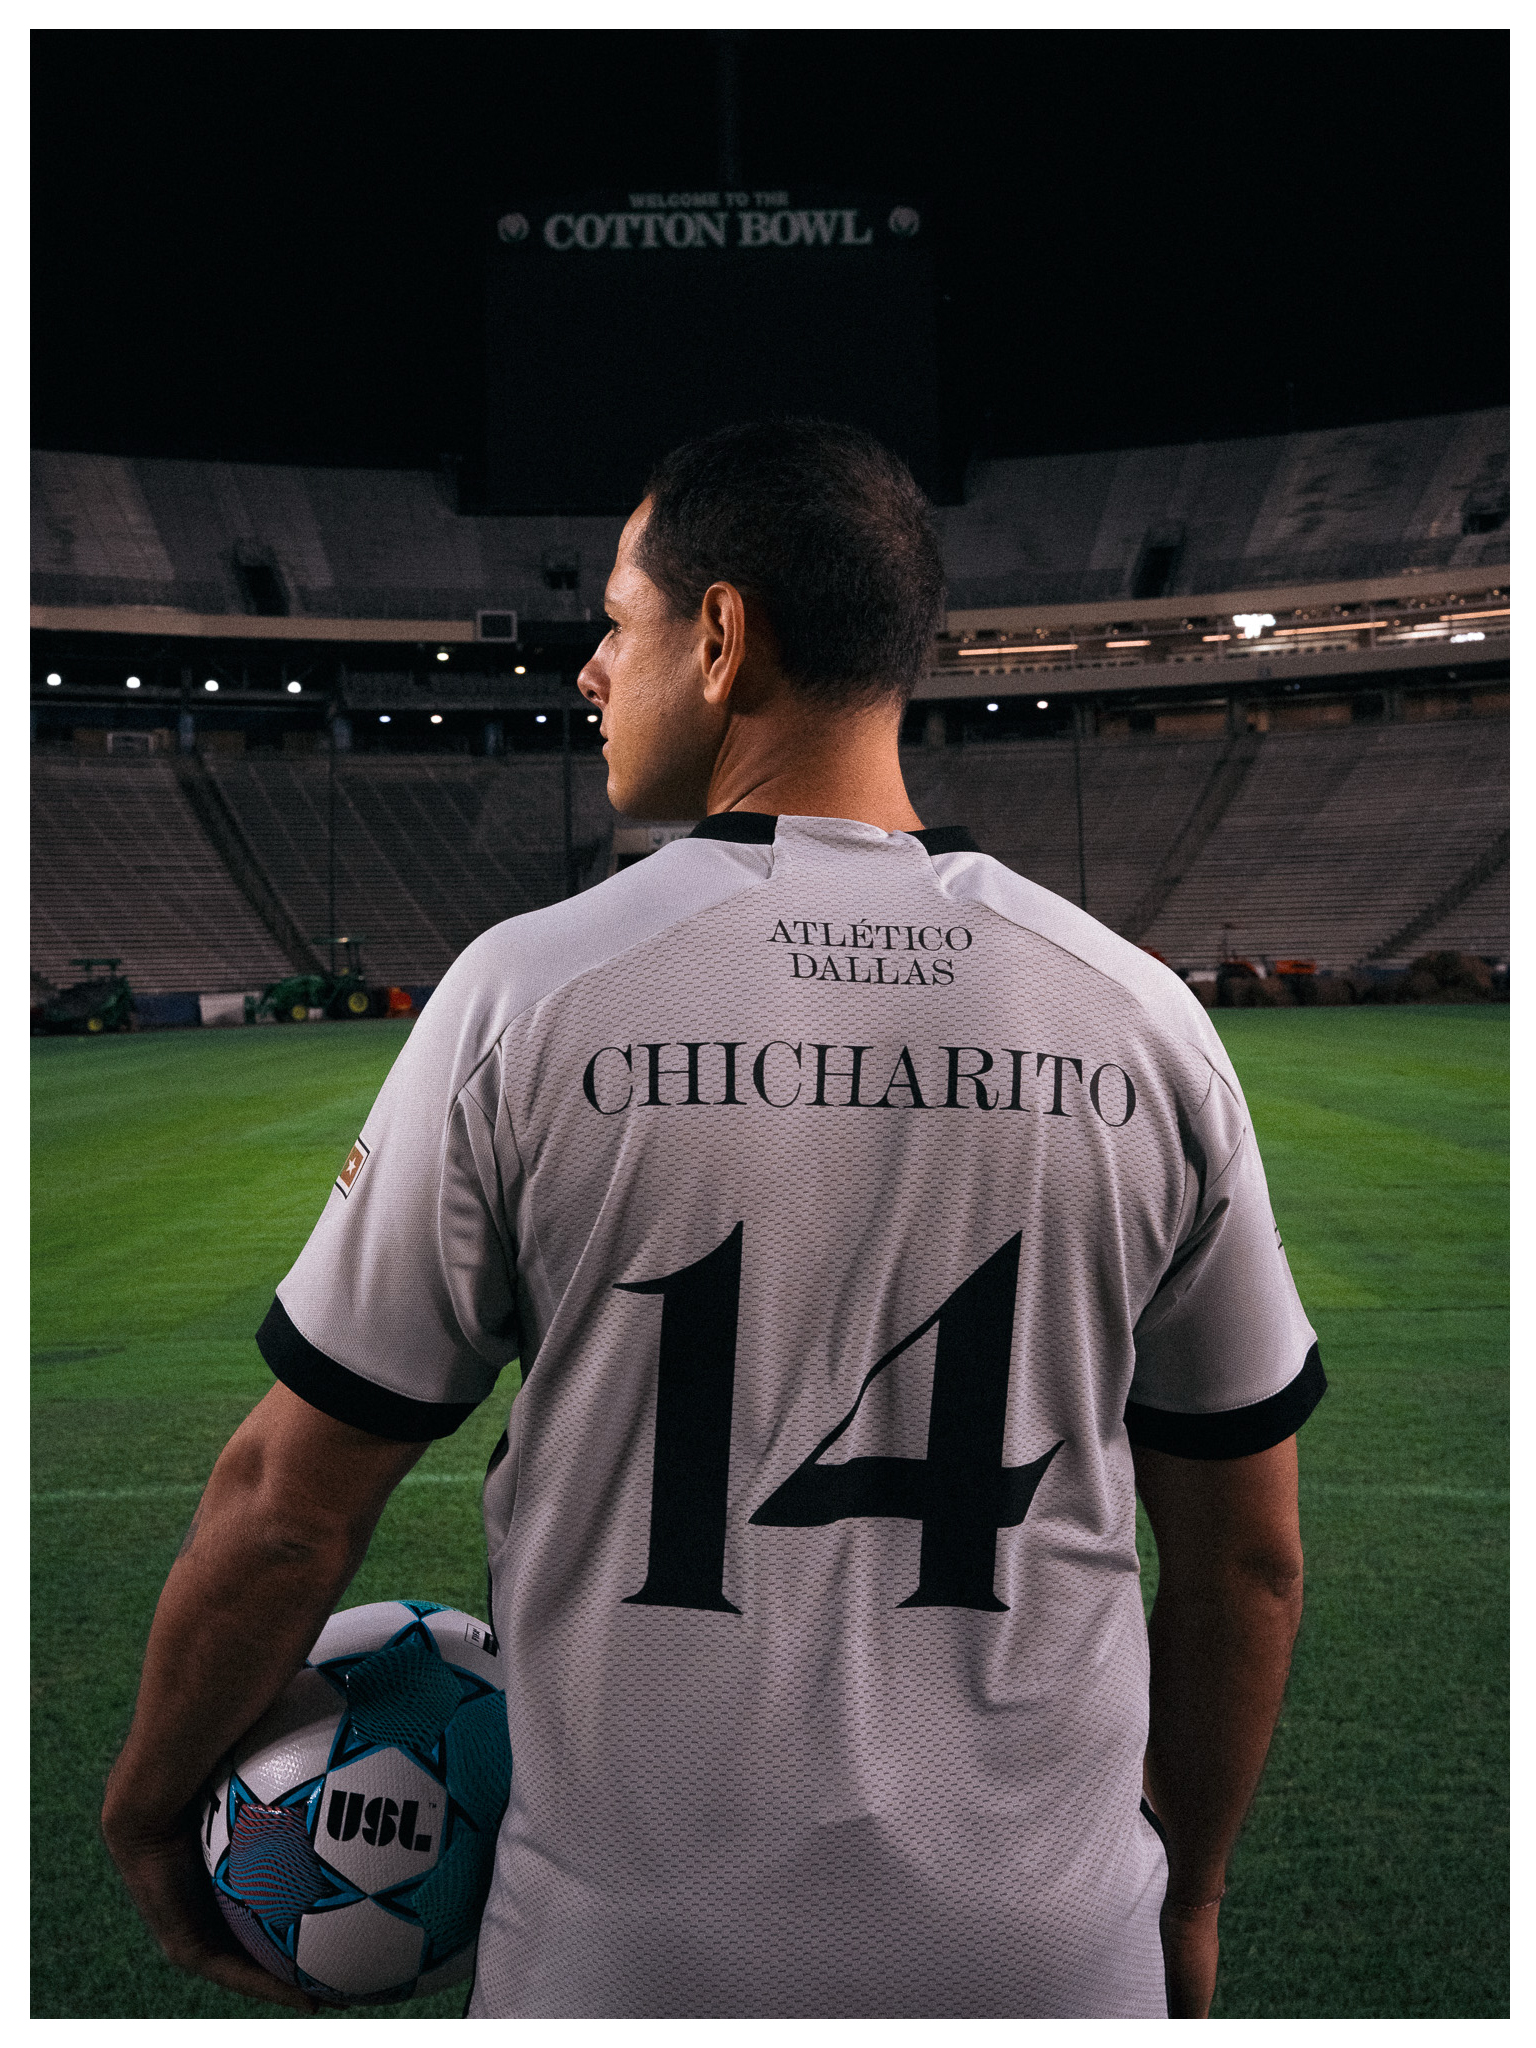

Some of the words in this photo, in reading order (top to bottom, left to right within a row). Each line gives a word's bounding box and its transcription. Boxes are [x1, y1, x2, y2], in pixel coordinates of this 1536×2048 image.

[628, 192, 719, 208] WELCOME
[724, 191, 749, 207] TO
[754, 190, 789, 206] THE
[544, 212, 728, 250] COTTON
[738, 209, 873, 248] BOWL
[767, 919, 973, 951] ATLÉTICO
[787, 952, 955, 985] DALLAS
[582, 1041, 1136, 1127] CHICHARITO
[612, 1220, 1065, 1615] 14
[326, 1789, 432, 1852] USL
